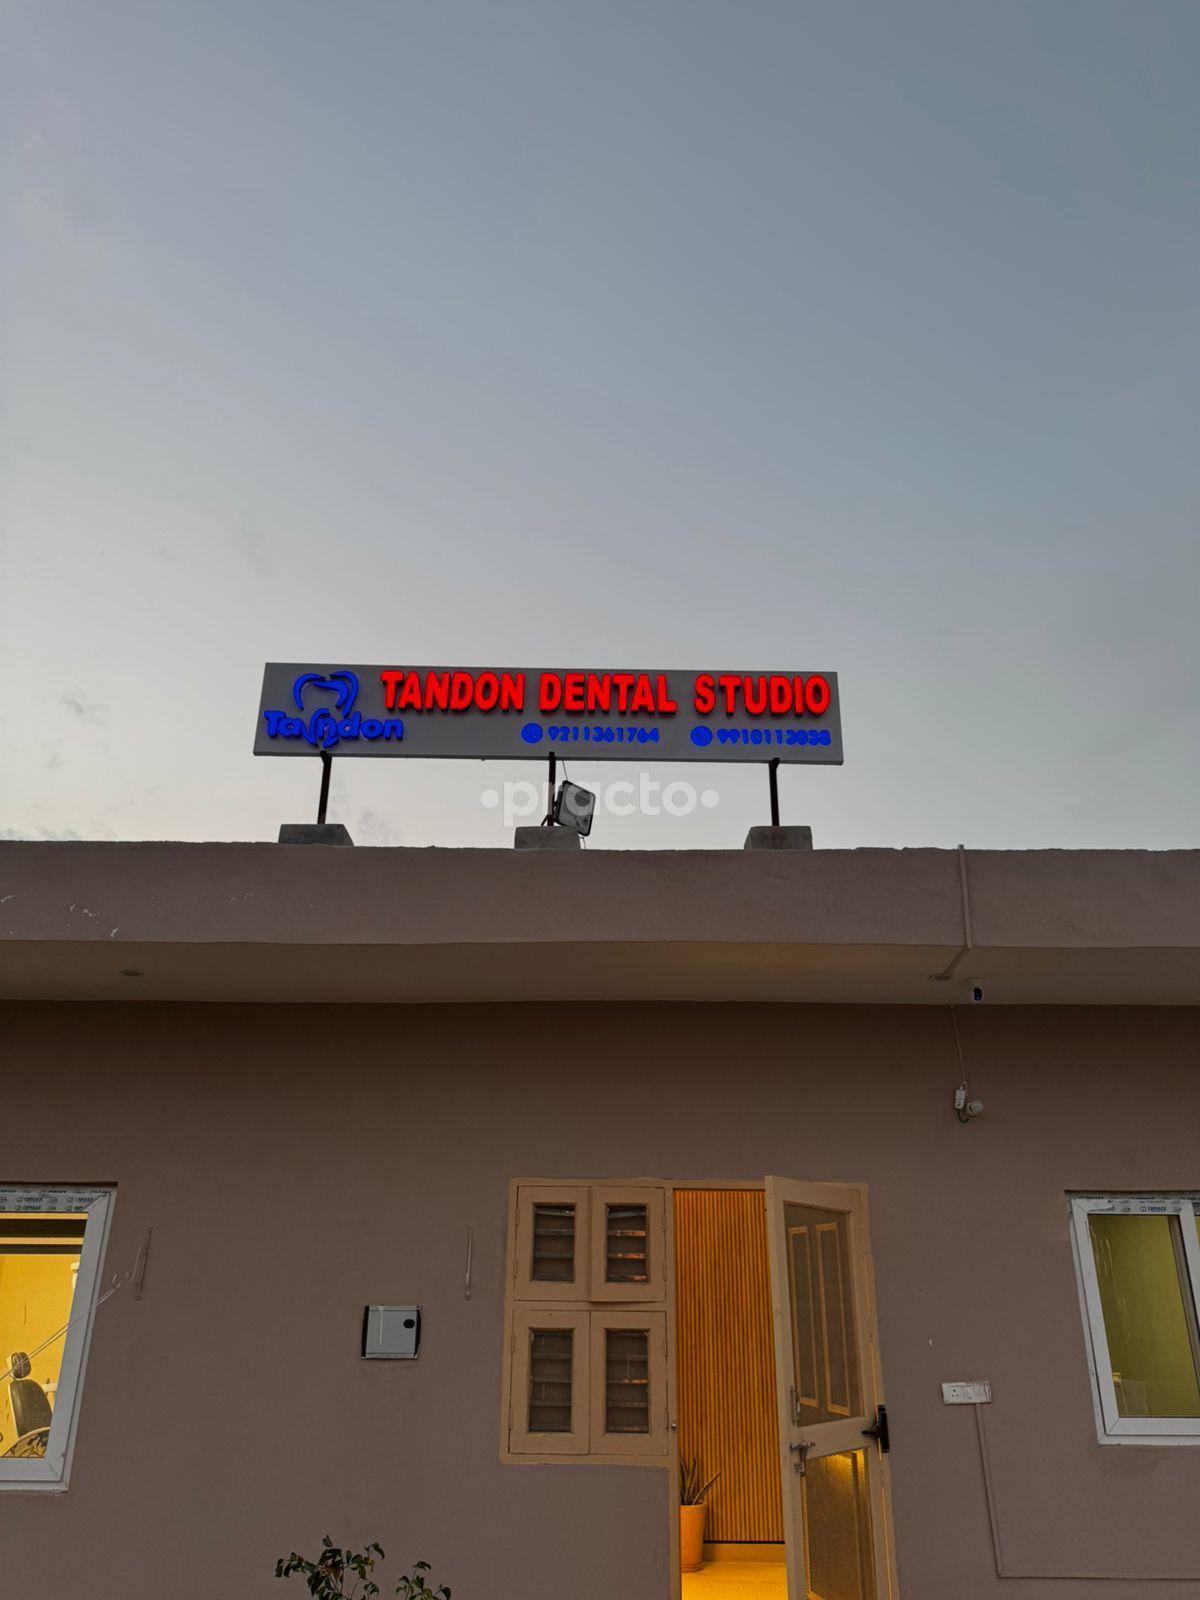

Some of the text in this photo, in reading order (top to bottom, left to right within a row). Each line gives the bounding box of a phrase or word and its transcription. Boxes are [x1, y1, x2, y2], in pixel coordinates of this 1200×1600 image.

[380, 669, 832, 717] TANDON DENTAL STUDIO
[263, 708, 405, 744] Tandon
[546, 724, 661, 746] 9211361764
[716, 726, 834, 748] 9910113038
